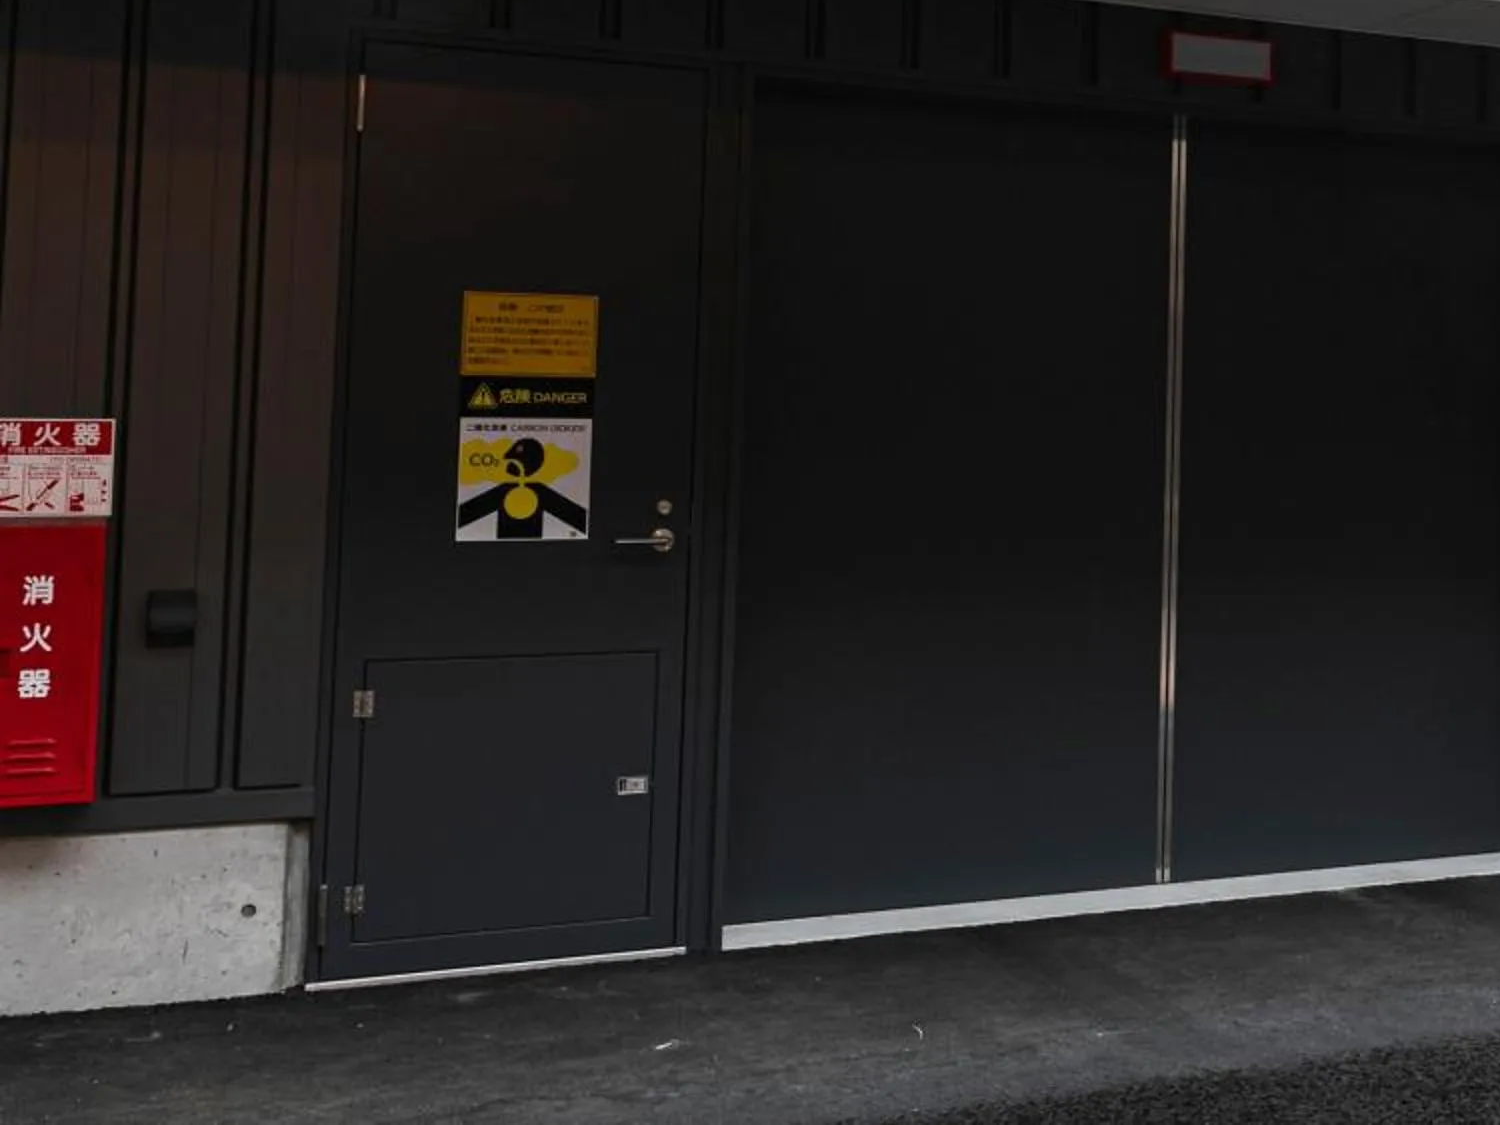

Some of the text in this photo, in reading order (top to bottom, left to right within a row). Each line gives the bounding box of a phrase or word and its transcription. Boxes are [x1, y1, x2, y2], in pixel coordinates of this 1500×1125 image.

[533, 391, 587, 404] DANGER
[0, 422, 101, 447] 消火器
[17, 574, 55, 699] 消火器
